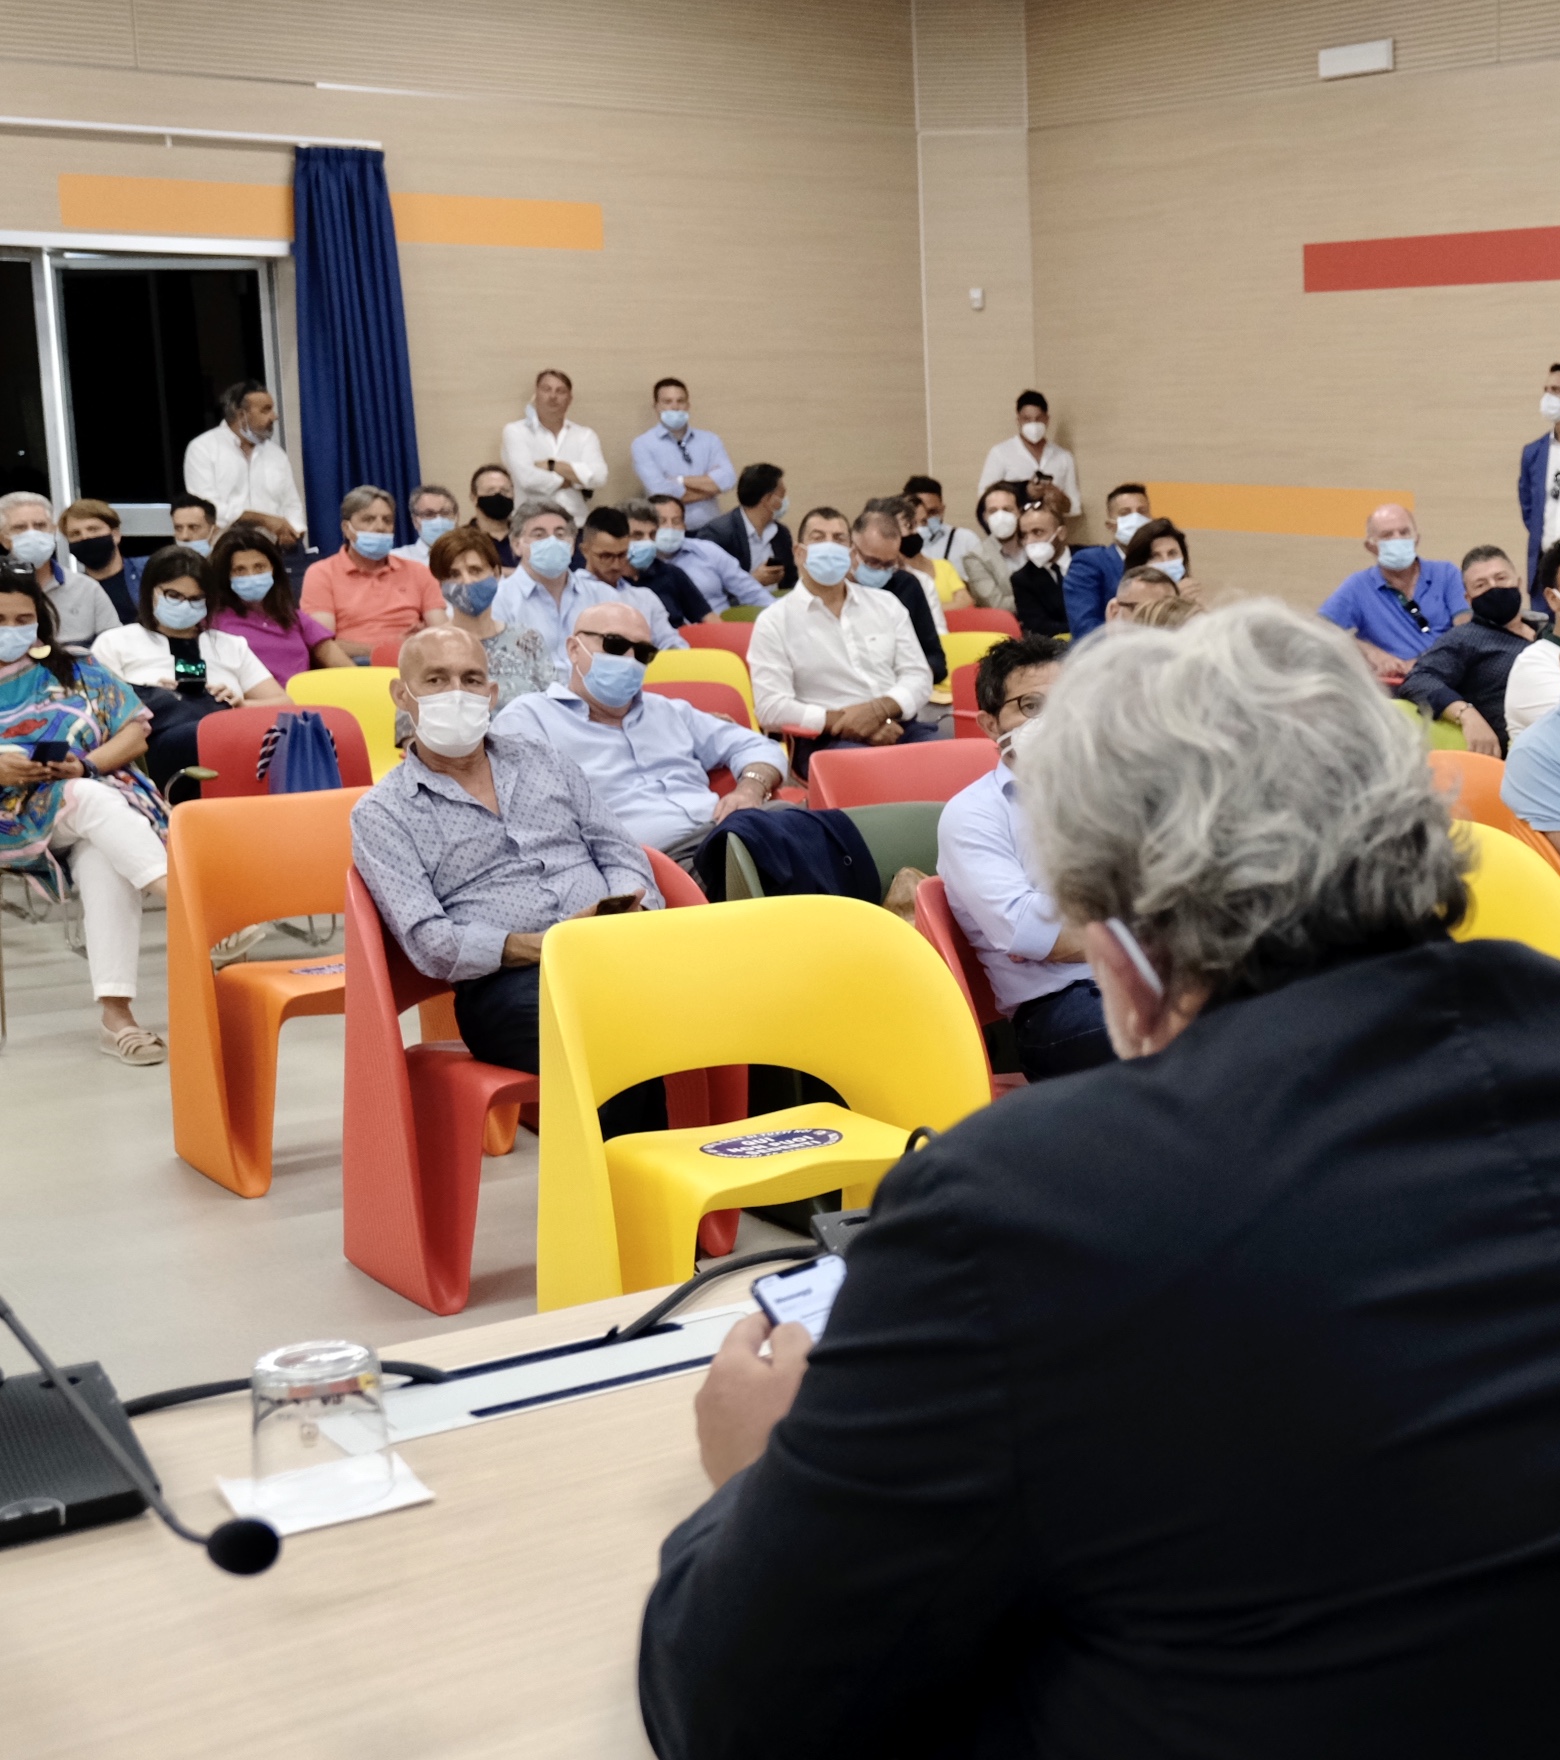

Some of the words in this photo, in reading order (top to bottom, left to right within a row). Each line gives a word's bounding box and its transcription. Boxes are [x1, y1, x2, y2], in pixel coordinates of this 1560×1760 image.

[726, 1144, 769, 1153] NON
[768, 1135, 814, 1147] PUOI
[741, 1137, 775, 1145] QUI
[745, 1140, 822, 1155] SEDERTI
